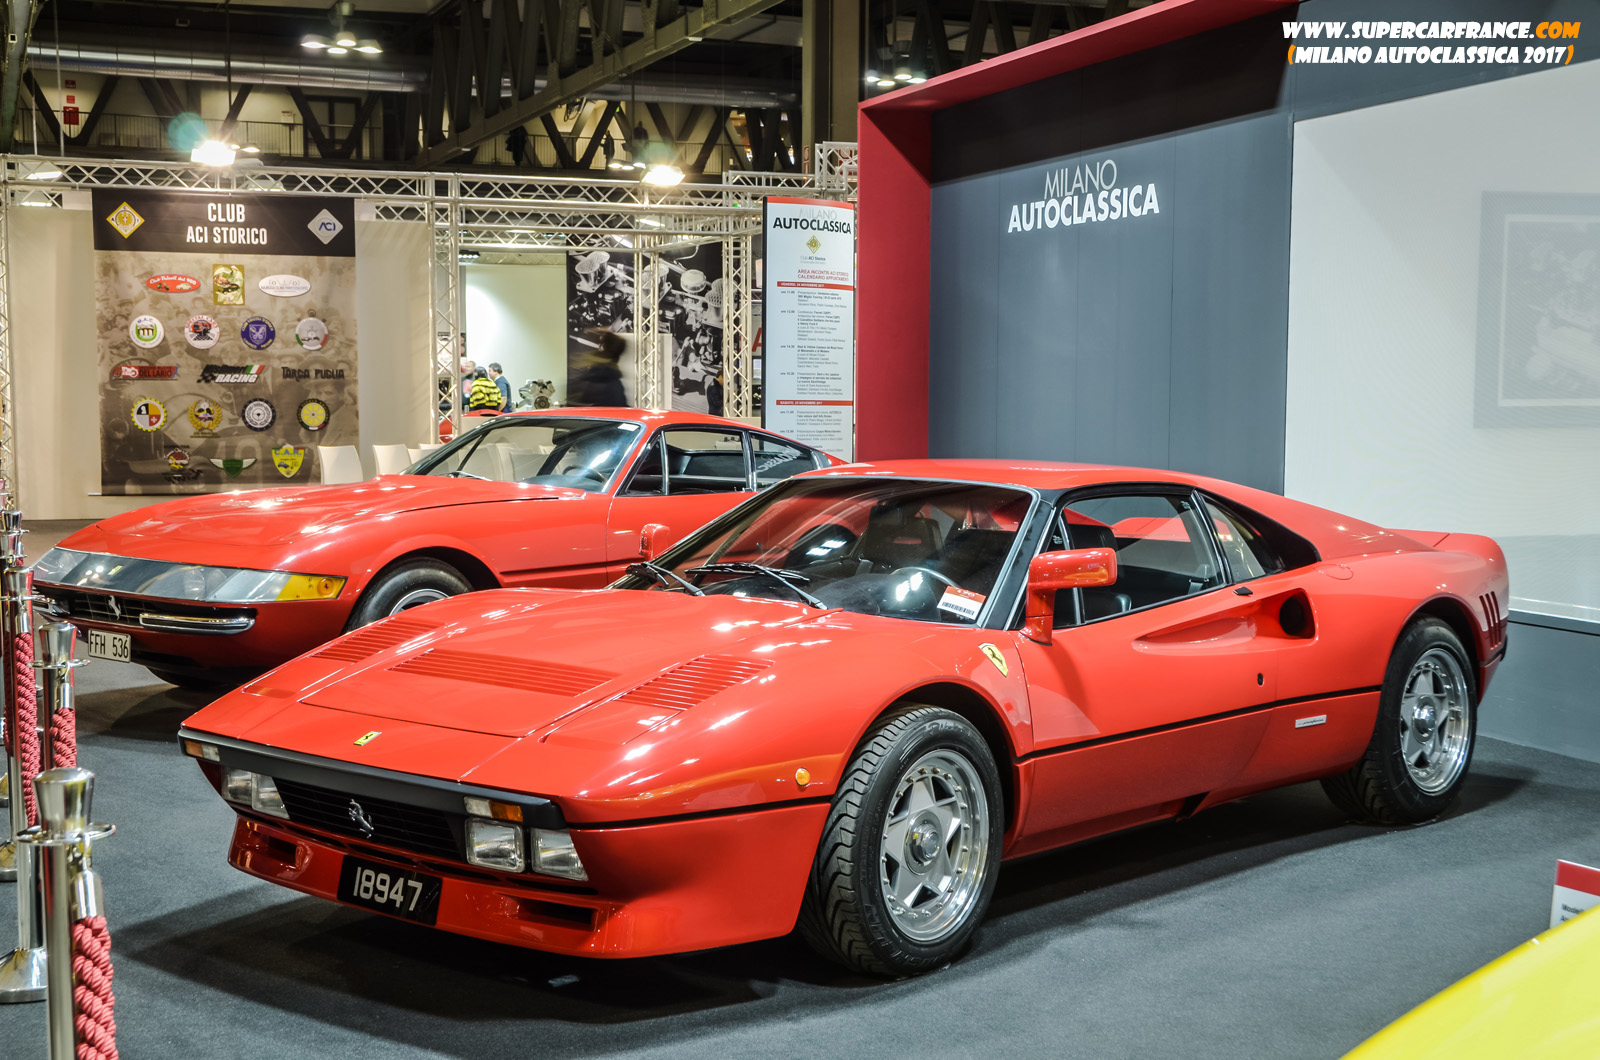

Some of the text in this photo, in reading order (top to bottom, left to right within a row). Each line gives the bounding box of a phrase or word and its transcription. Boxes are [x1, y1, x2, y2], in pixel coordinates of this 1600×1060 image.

[1044, 159, 1117, 200] MILANO
[207, 202, 246, 223] CLUB
[1007, 183, 1160, 233] AUTOCLASSICA
[186, 226, 268, 245] ACI STORICO
[773, 217, 852, 234] AUTOCLASSICA
[215, 374, 258, 383] RACING
[90, 633, 128, 658] FFH 536
[353, 866, 423, 912] 18947
